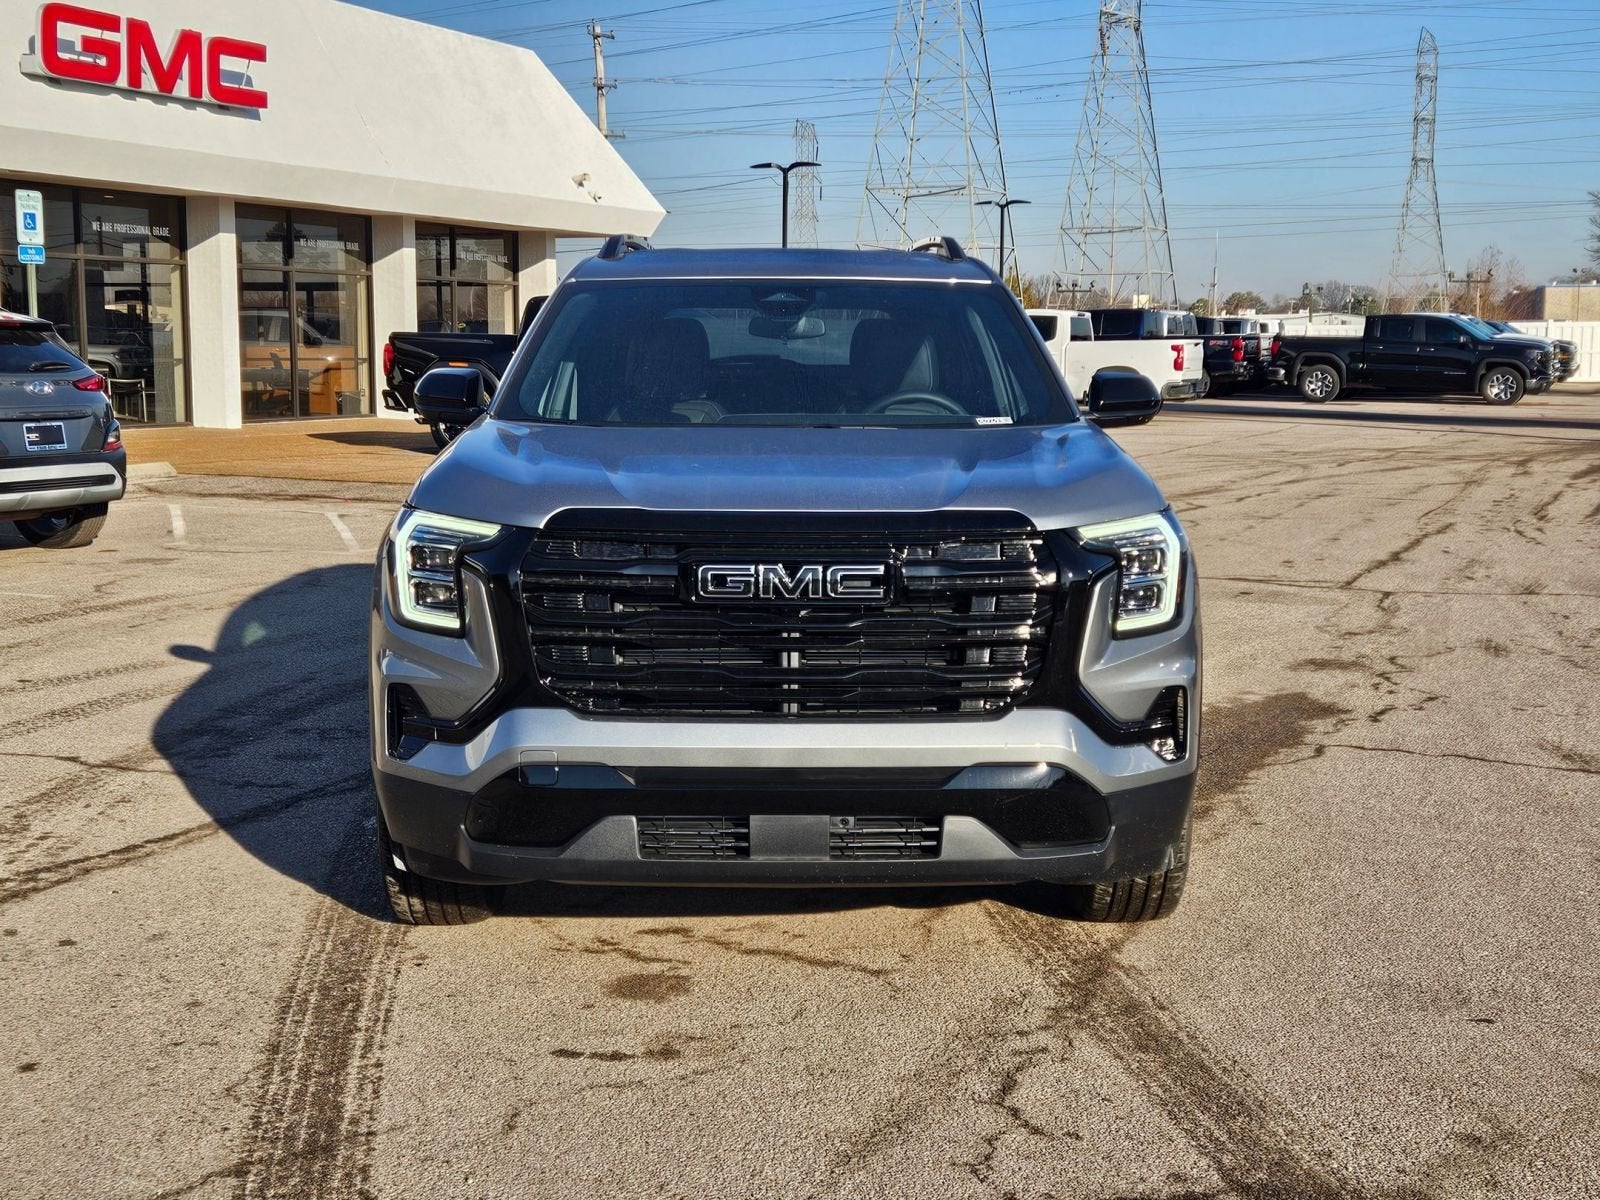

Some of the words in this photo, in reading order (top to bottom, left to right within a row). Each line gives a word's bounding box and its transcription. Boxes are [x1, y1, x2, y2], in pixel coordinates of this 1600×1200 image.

[41, 2, 268, 109] GMC
[92, 221, 101, 232] WE
[102, 222, 113, 233] ARE
[113, 223, 151, 236] PROFESSIONAL
[698, 563, 886, 599] GMC
